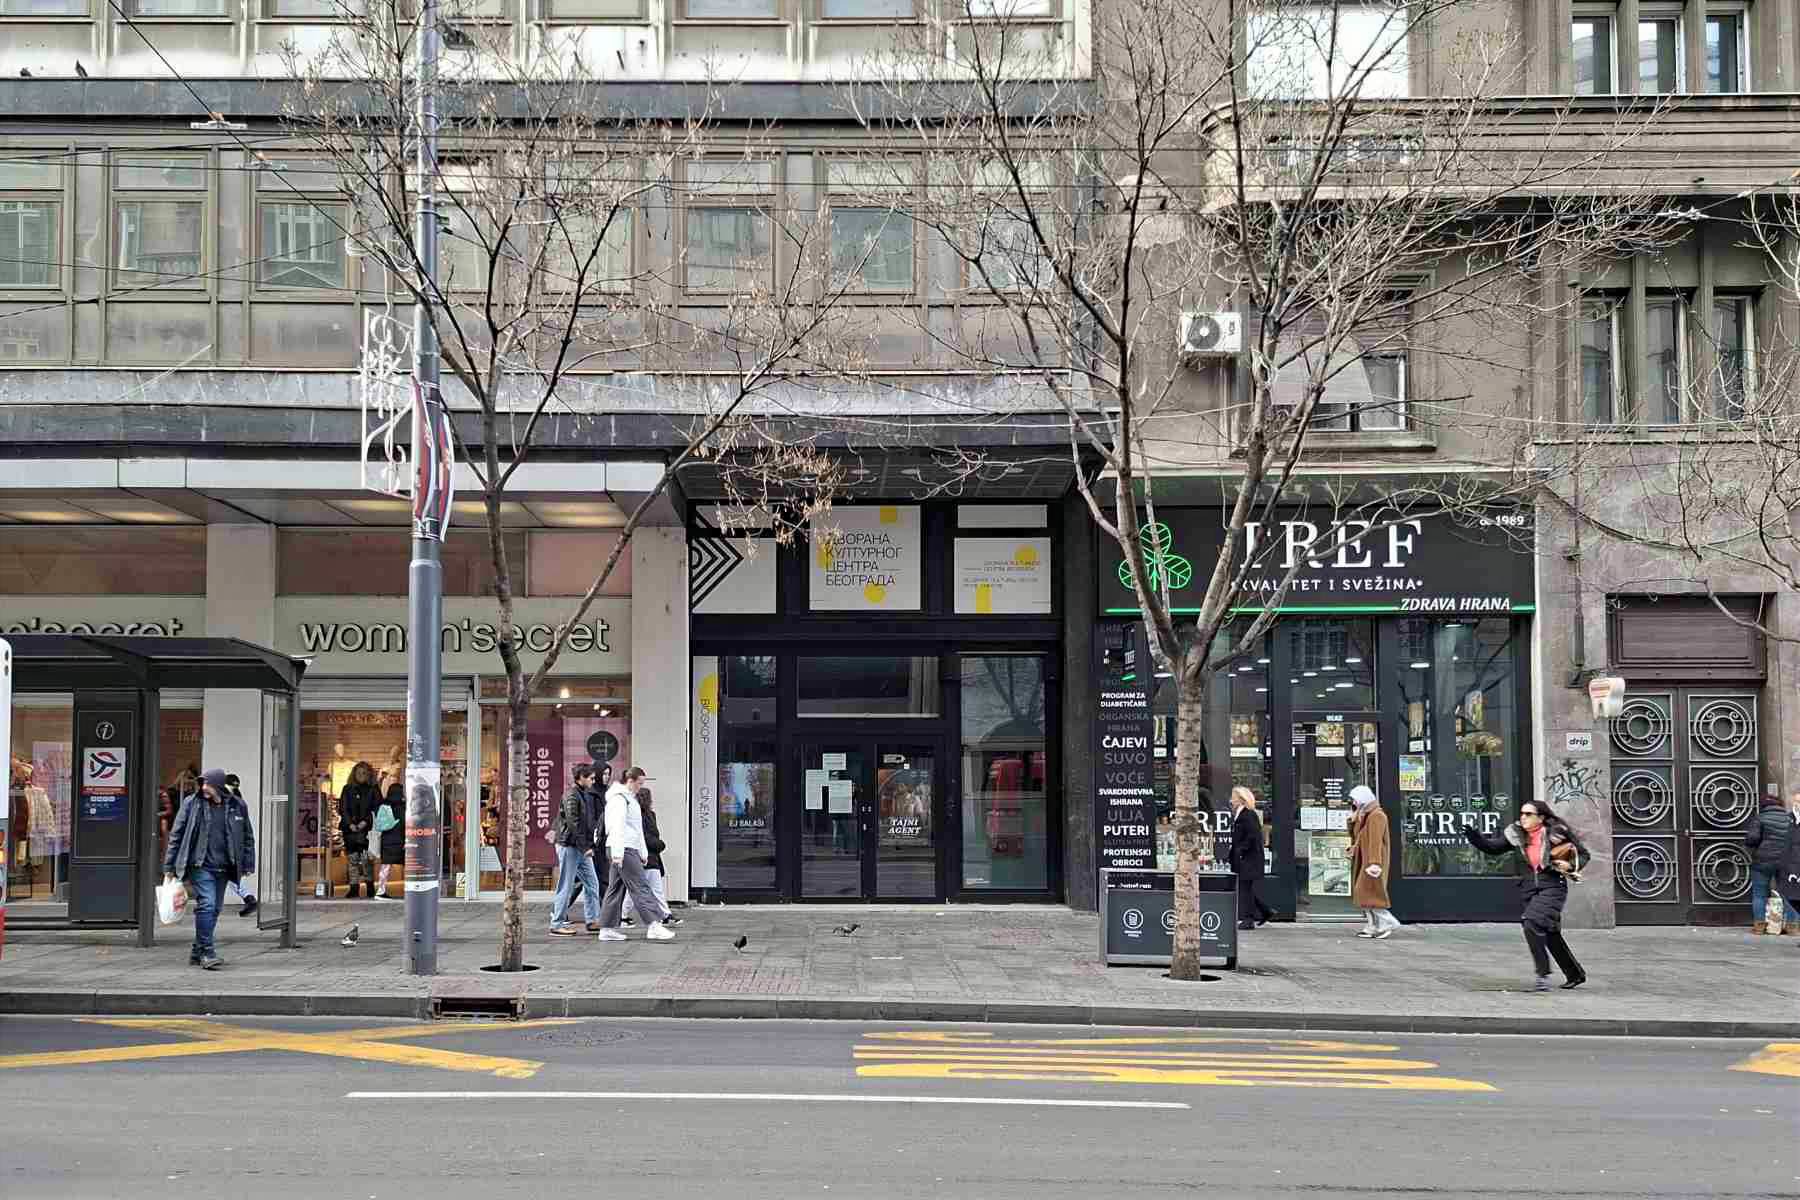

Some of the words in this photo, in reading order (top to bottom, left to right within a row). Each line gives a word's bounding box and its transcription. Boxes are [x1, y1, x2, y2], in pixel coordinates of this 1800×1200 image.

[1496, 515, 1524, 526] 1989
[1240, 520, 1421, 568] TREF
[826, 560, 879, 573] ЦЕНТРА
[826, 574, 896, 586] БЕОГРАДА
[1240, 579, 1321, 591] KVALTET
[1342, 575, 1416, 591] SVEŽINA
[1400, 597, 1456, 611] ZDRAVA
[1460, 597, 1511, 611] HRANA
[1102, 735, 1147, 748] ČAJEVI
[1569, 737, 1589, 746] drip
[1104, 752, 1147, 765] SUVO
[1105, 770, 1145, 784] VOĆE
[532, 747, 554, 828] sniženje
[1107, 810, 1145, 821] ULJA
[1414, 812, 1501, 834] TREF
[1104, 825, 1149, 836] PUTERI
